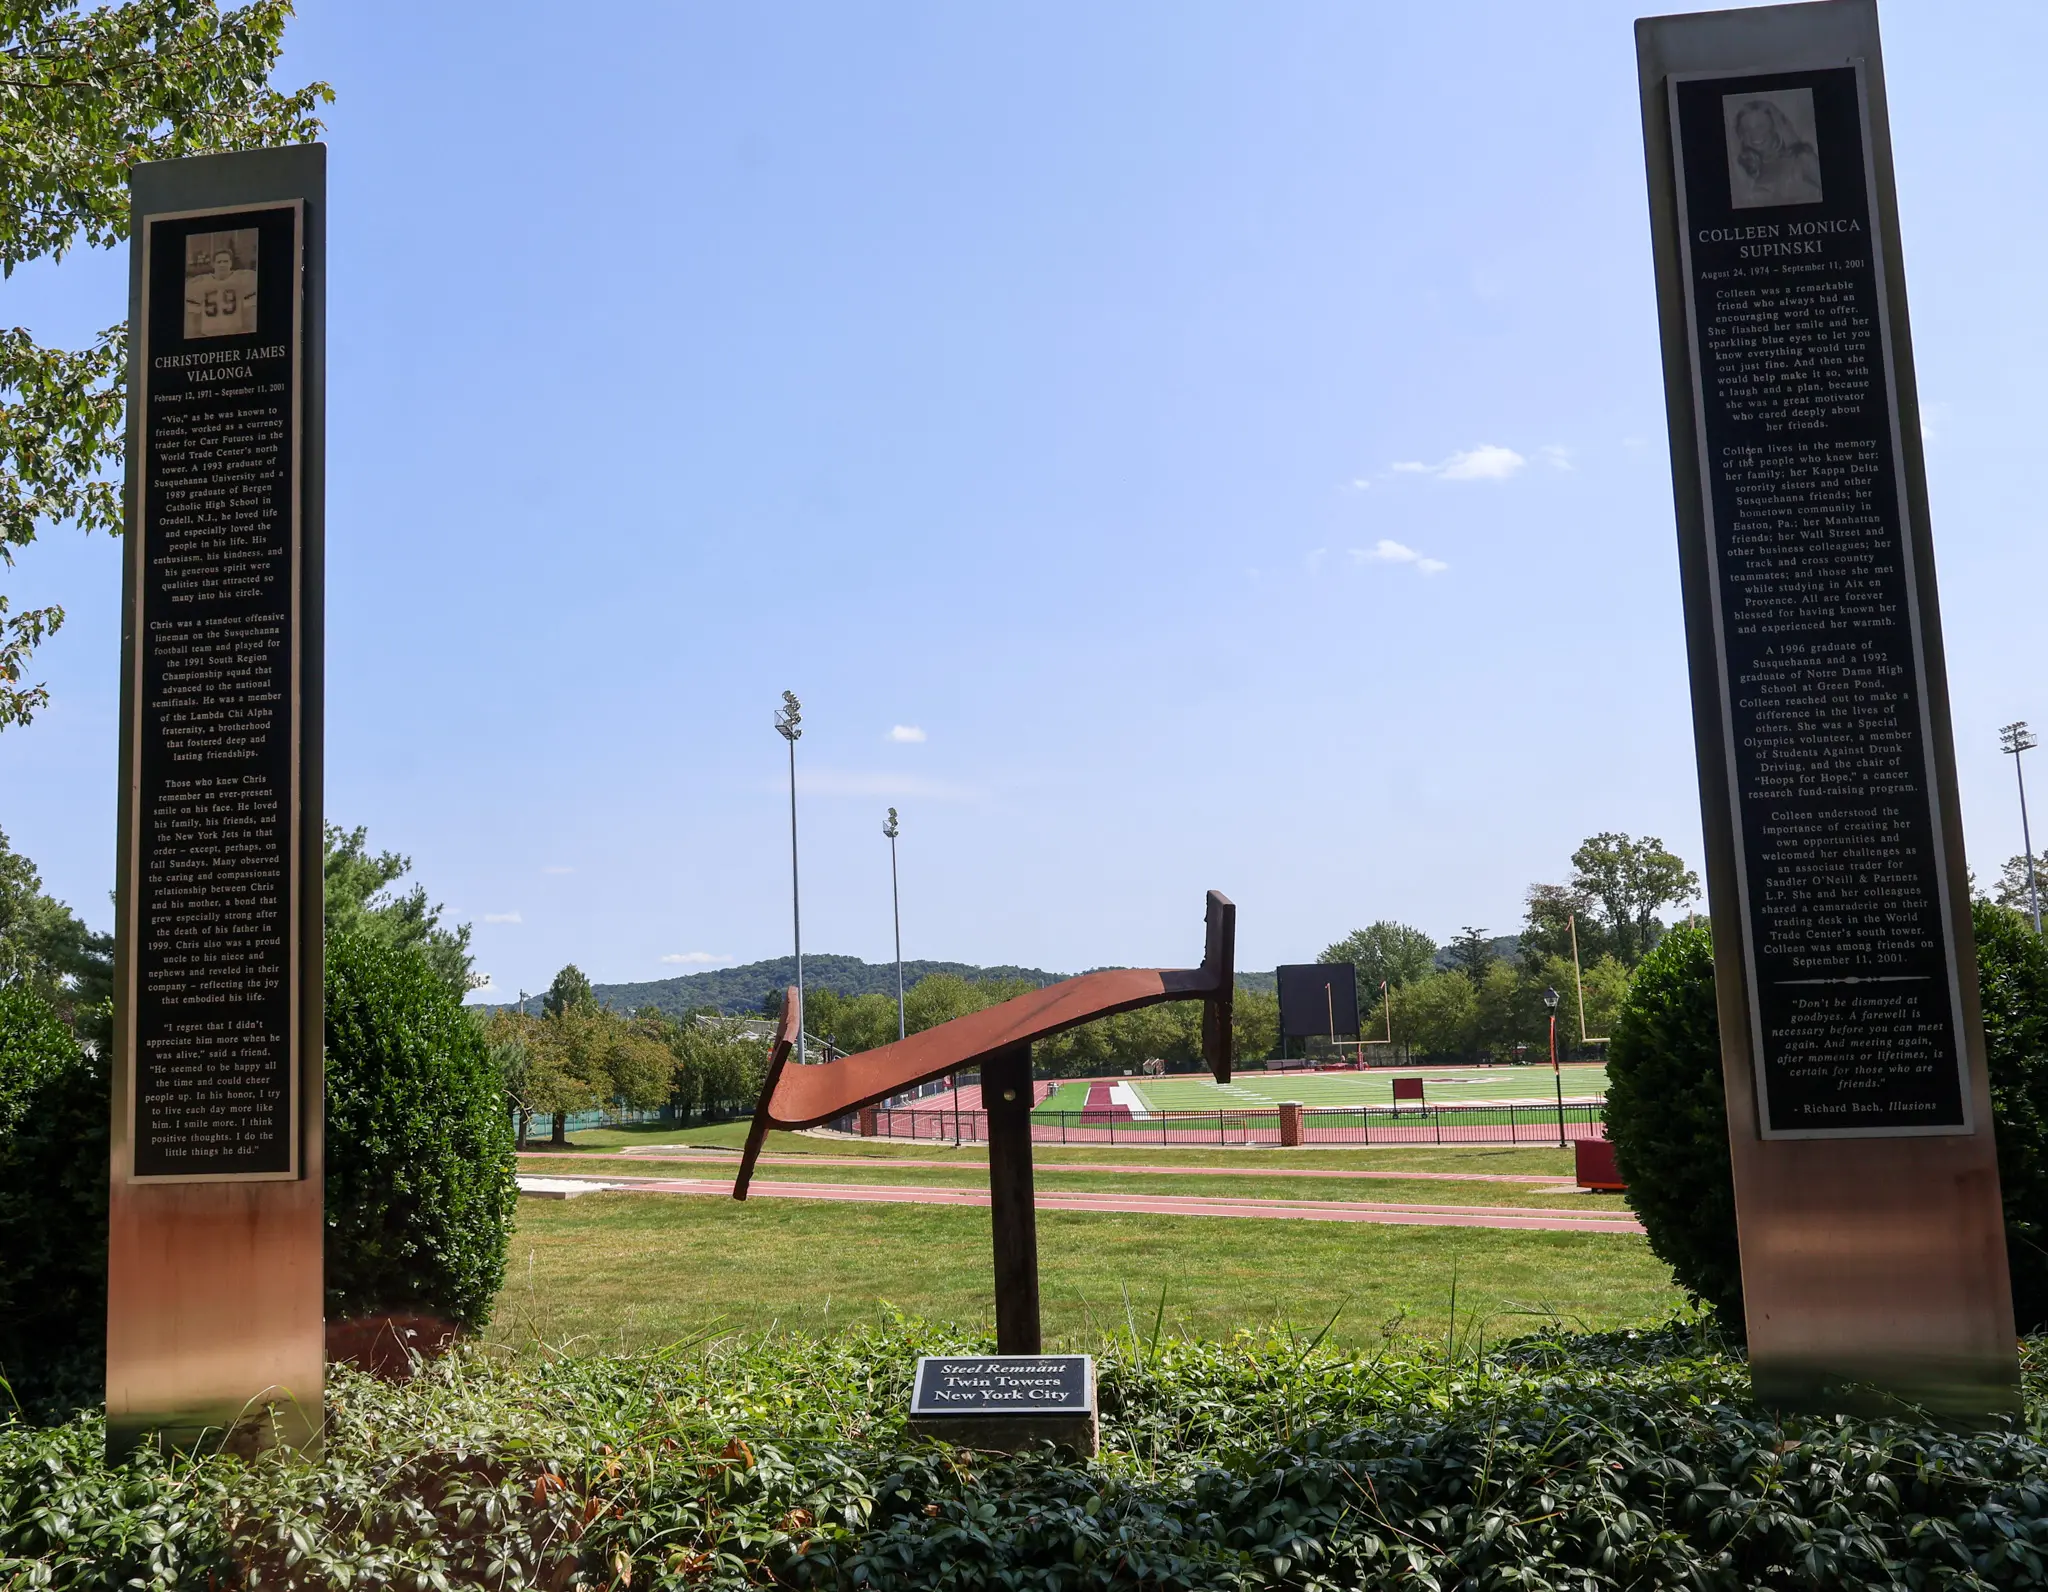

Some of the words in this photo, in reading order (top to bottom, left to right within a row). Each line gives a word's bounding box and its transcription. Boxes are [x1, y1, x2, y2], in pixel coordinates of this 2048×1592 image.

[1698, 224, 1779, 243] COLLEEN
[1787, 218, 1861, 236] MONICA
[1740, 239, 1823, 259] SUPINSKI
[1701, 270, 1730, 281] August
[1733, 267, 1746, 277] 24,
[1750, 266, 1770, 276] 1974
[1782, 262, 1825, 275] September
[1829, 260, 1842, 270] 11,
[1845, 259, 1864, 269] 2001
[1716, 289, 1756, 299] Colleen
[1760, 287, 1780, 295] was
[1796, 280, 1853, 293] remarkable
[204, 288, 238, 318] 59
[154, 349, 241, 369] CHRISTOPHER
[245, 345, 285, 360] JAMES
[1715, 351, 1742, 360] know
[1747, 346, 1803, 359] everything
[1807, 343, 1840, 353] would
[1844, 343, 1866, 351] turn
[186, 365, 253, 382] VIALONGA
[154, 394, 182, 402] February
[184, 391, 195, 400] 12,
[197, 389, 212, 399] 1971
[221, 386, 255, 398] September
[257, 384, 267, 393] 11,
[269, 383, 285, 392] 2001
[1732, 412, 1754, 421] who
[1758, 408, 1787, 419] cared
[1791, 406, 1826, 418] deeply
[1831, 405, 1860, 415] about
[155, 440, 180, 450] trader
[183, 438, 197, 447] for
[199, 437, 219, 446] Carr
[222, 434, 254, 444] Futures
[257, 432, 266, 441] in
[269, 431, 283, 439] the
[154, 477, 208, 488] Susquehanna
[211, 471, 256, 483] University
[259, 469, 275, 479] and
[1735, 482, 1776, 493] sorority
[1781, 480, 1816, 490] sisters
[1820, 478, 1839, 488] and
[1844, 476, 1872, 486] other
[165, 502, 202, 512] Catholic
[205, 499, 226, 510] High
[229, 496, 258, 507] School
[262, 496, 271, 505] in
[1745, 558, 1773, 568] track
[1778, 556, 1797, 567] and
[1801, 557, 1829, 565] cross
[1834, 554, 1874, 564] country
[1744, 597, 1797, 607] Provence.
[1801, 593, 1818, 604] All
[1823, 594, 1840, 602] are
[1844, 591, 1883, 601] forever
[149, 620, 173, 630] Chris
[176, 620, 193, 628] was
[204, 616, 241, 626] standout
[245, 612, 285, 623] offensive
[154, 645, 188, 656] football
[191, 645, 212, 653] team
[215, 642, 231, 651] and
[234, 639, 263, 652] played
[267, 638, 281, 648] for
[166, 659, 180, 668] the
[184, 657, 204, 667] 1991
[208, 655, 233, 665] South
[236, 653, 267, 664] Region
[1752, 657, 1822, 669] Susquehanna
[1826, 654, 1846, 664] and
[1850, 655, 1857, 663] a
[1862, 652, 1888, 662] 1992
[1739, 672, 1786, 684] graduate
[1790, 670, 1802, 679] of
[1806, 669, 1837, 679] Notre
[1841, 667, 1872, 677] Dame
[1877, 664, 1903, 676] High
[159, 713, 170, 722] of
[173, 713, 187, 721] the
[190, 710, 224, 721] Lambda
[227, 709, 243, 718] Chi
[246, 707, 273, 718] Alpha
[173, 751, 203, 762] lasting
[206, 748, 258, 759] friendships.
[1755, 749, 1767, 759] of
[1772, 747, 1818, 759] Students
[1822, 745, 1864, 758] Against
[1869, 743, 1903, 754] Drunk
[164, 779, 191, 788] Those
[194, 777, 213, 786] who
[216, 776, 239, 785] knew
[242, 774, 266, 784] Chris
[158, 791, 201, 802] remember
[218, 788, 273, 799] ever-present
[1748, 788, 1793, 799] research
[1797, 785, 1865, 797] fund-raising
[1869, 784, 1918, 796] program.
[157, 833, 171, 842] the
[175, 832, 194, 841] New
[197, 830, 218, 840] York
[221, 830, 239, 839] Jets
[242, 829, 252, 838] in
[255, 828, 273, 837] that
[1776, 839, 1798, 847] own
[1803, 834, 1875, 848] opportunities
[1880, 832, 1900, 843] and
[1765, 877, 1807, 887] Sandler
[1858, 874, 1868, 883] &
[1873, 873, 1918, 883] Partners
[154, 885, 207, 896] relationship
[210, 884, 246, 893] between
[250, 882, 274, 892] Chris
[1774, 916, 1813, 928] trading
[1817, 915, 1843, 925] desk
[1847, 914, 1859, 924] in
[1863, 914, 1881, 923] the
[1884, 912, 1918, 922] World
[161, 995, 179, 1005] that
[182, 993, 225, 1004] embodied
[228, 993, 242, 1002] his
[246, 992, 265, 1001] life.
[1771, 1027, 1825, 1037] necessary
[1829, 1024, 1864, 1036] before
[1868, 1025, 1888, 1035] you
[1893, 1024, 1912, 1032] can
[1917, 1023, 1943, 1031] meet
[155, 1078, 170, 1087] the
[173, 1078, 193, 1087] time
[197, 1077, 213, 1086] and
[216, 1076, 242, 1085] could
[245, 1075, 270, 1084] cheer
[1803, 1103, 1847, 1114] Richard
[1851, 1102, 1883, 1112] Bach,
[1888, 1101, 1936, 1111] Illusions
[941, 1364, 981, 1374] Steel
[985, 1364, 1067, 1373] Remnant
[944, 1377, 990, 1387] Twin
[995, 1376, 1061, 1386] Towers
[934, 1391, 976, 1401] New
[980, 1390, 1023, 1400] York
[1029, 1390, 1070, 1401] City
